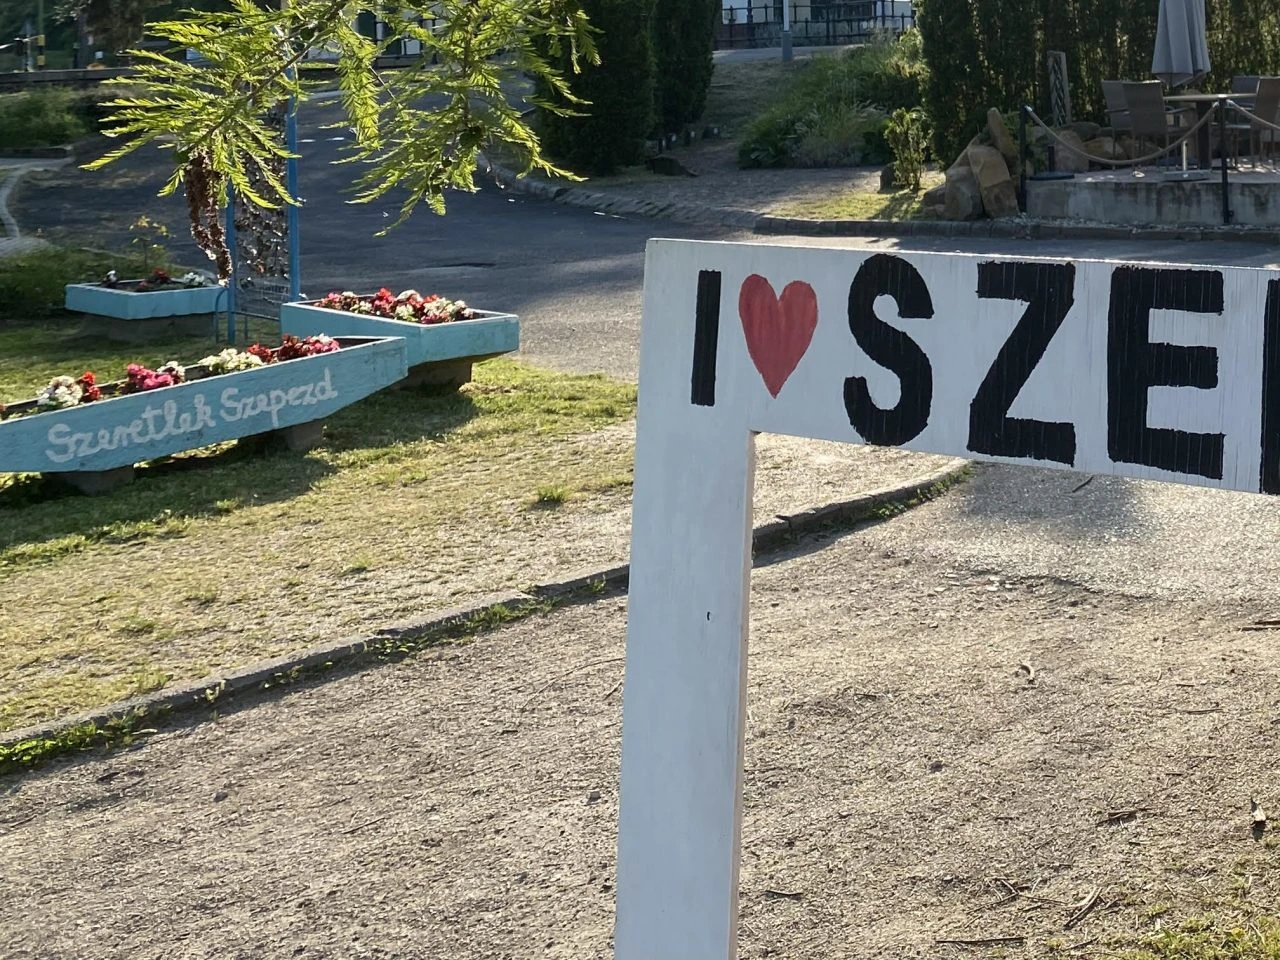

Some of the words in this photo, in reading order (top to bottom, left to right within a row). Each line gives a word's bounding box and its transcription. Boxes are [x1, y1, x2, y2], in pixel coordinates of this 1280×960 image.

[691, 270, 721, 408] I
[45, 393, 217, 463] Szeretlek
[219, 367, 339, 429] Szepezd
